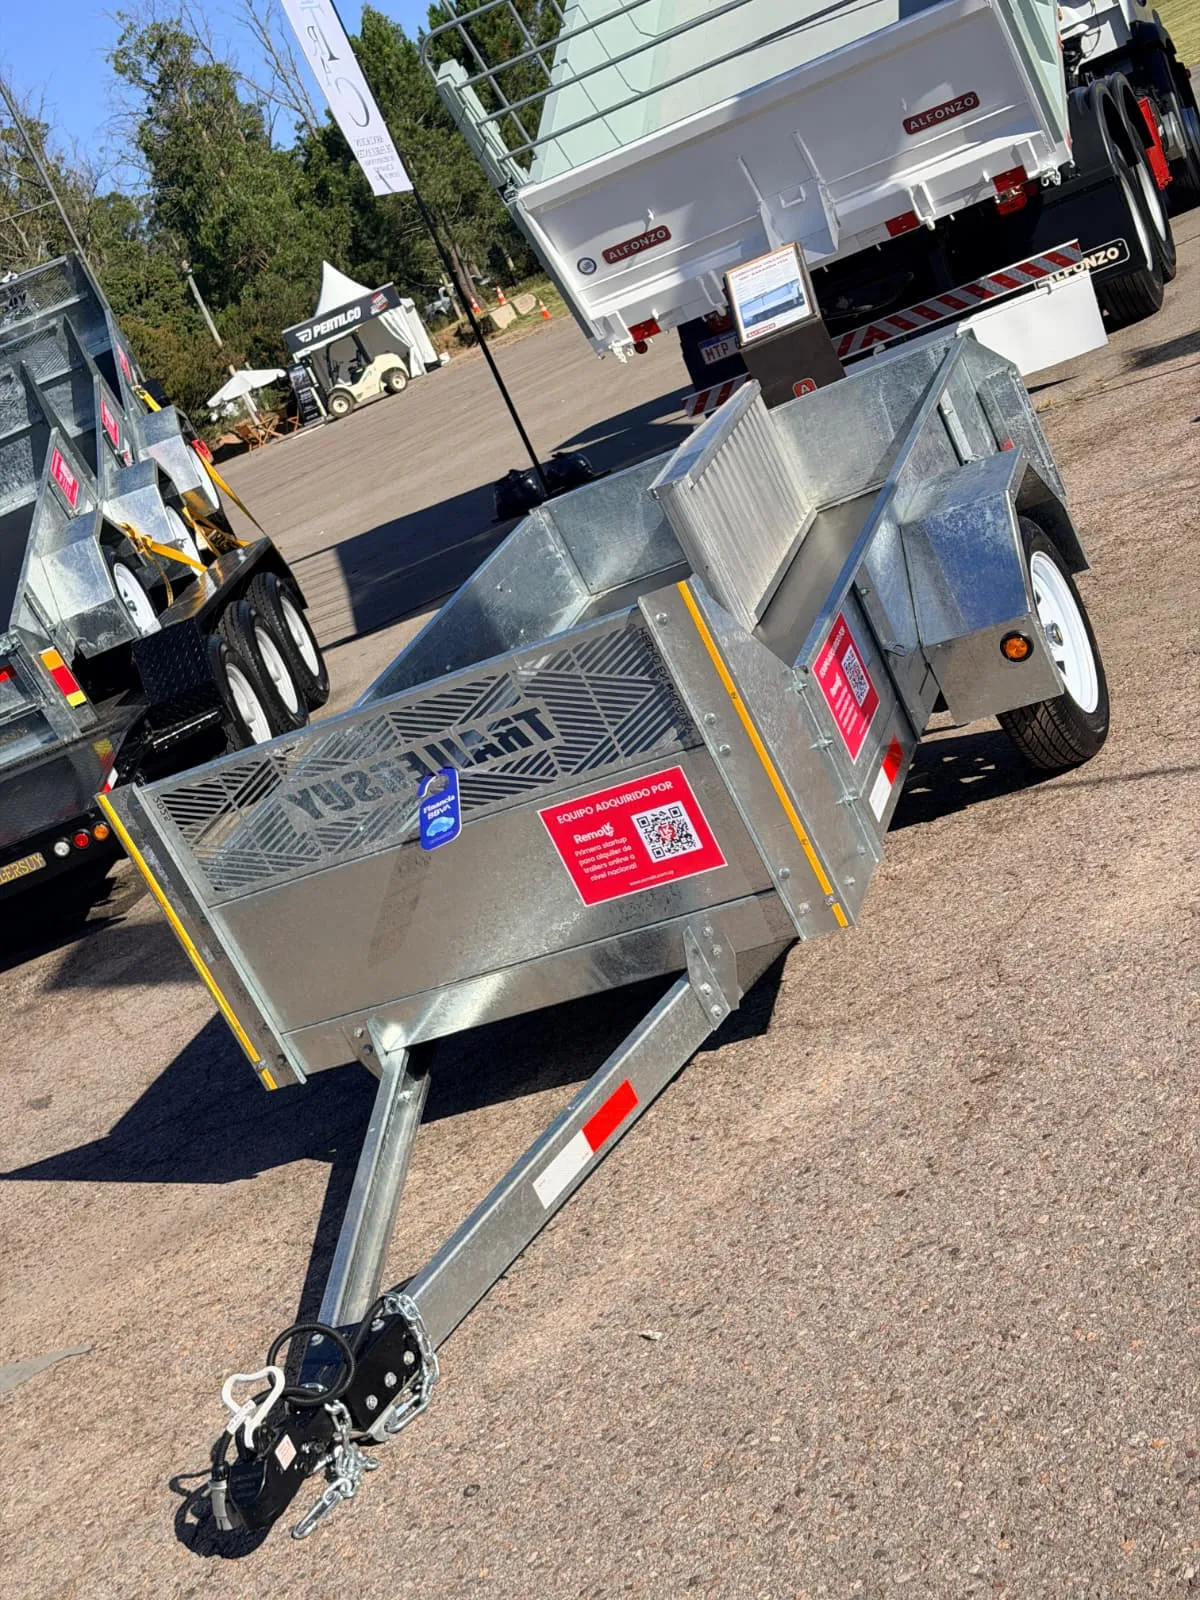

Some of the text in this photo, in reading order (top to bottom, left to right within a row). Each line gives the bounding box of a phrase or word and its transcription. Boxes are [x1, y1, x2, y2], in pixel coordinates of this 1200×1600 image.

[910, 96, 974, 130] ALFONZO
[608, 229, 666, 260] ALFONZO
[800, 383, 811, 396] A
[427, 803, 451, 820] BBVA
[556, 780, 673, 824] EQUIPO ADQUIRIDO POR
[622, 844, 632, 853] de
